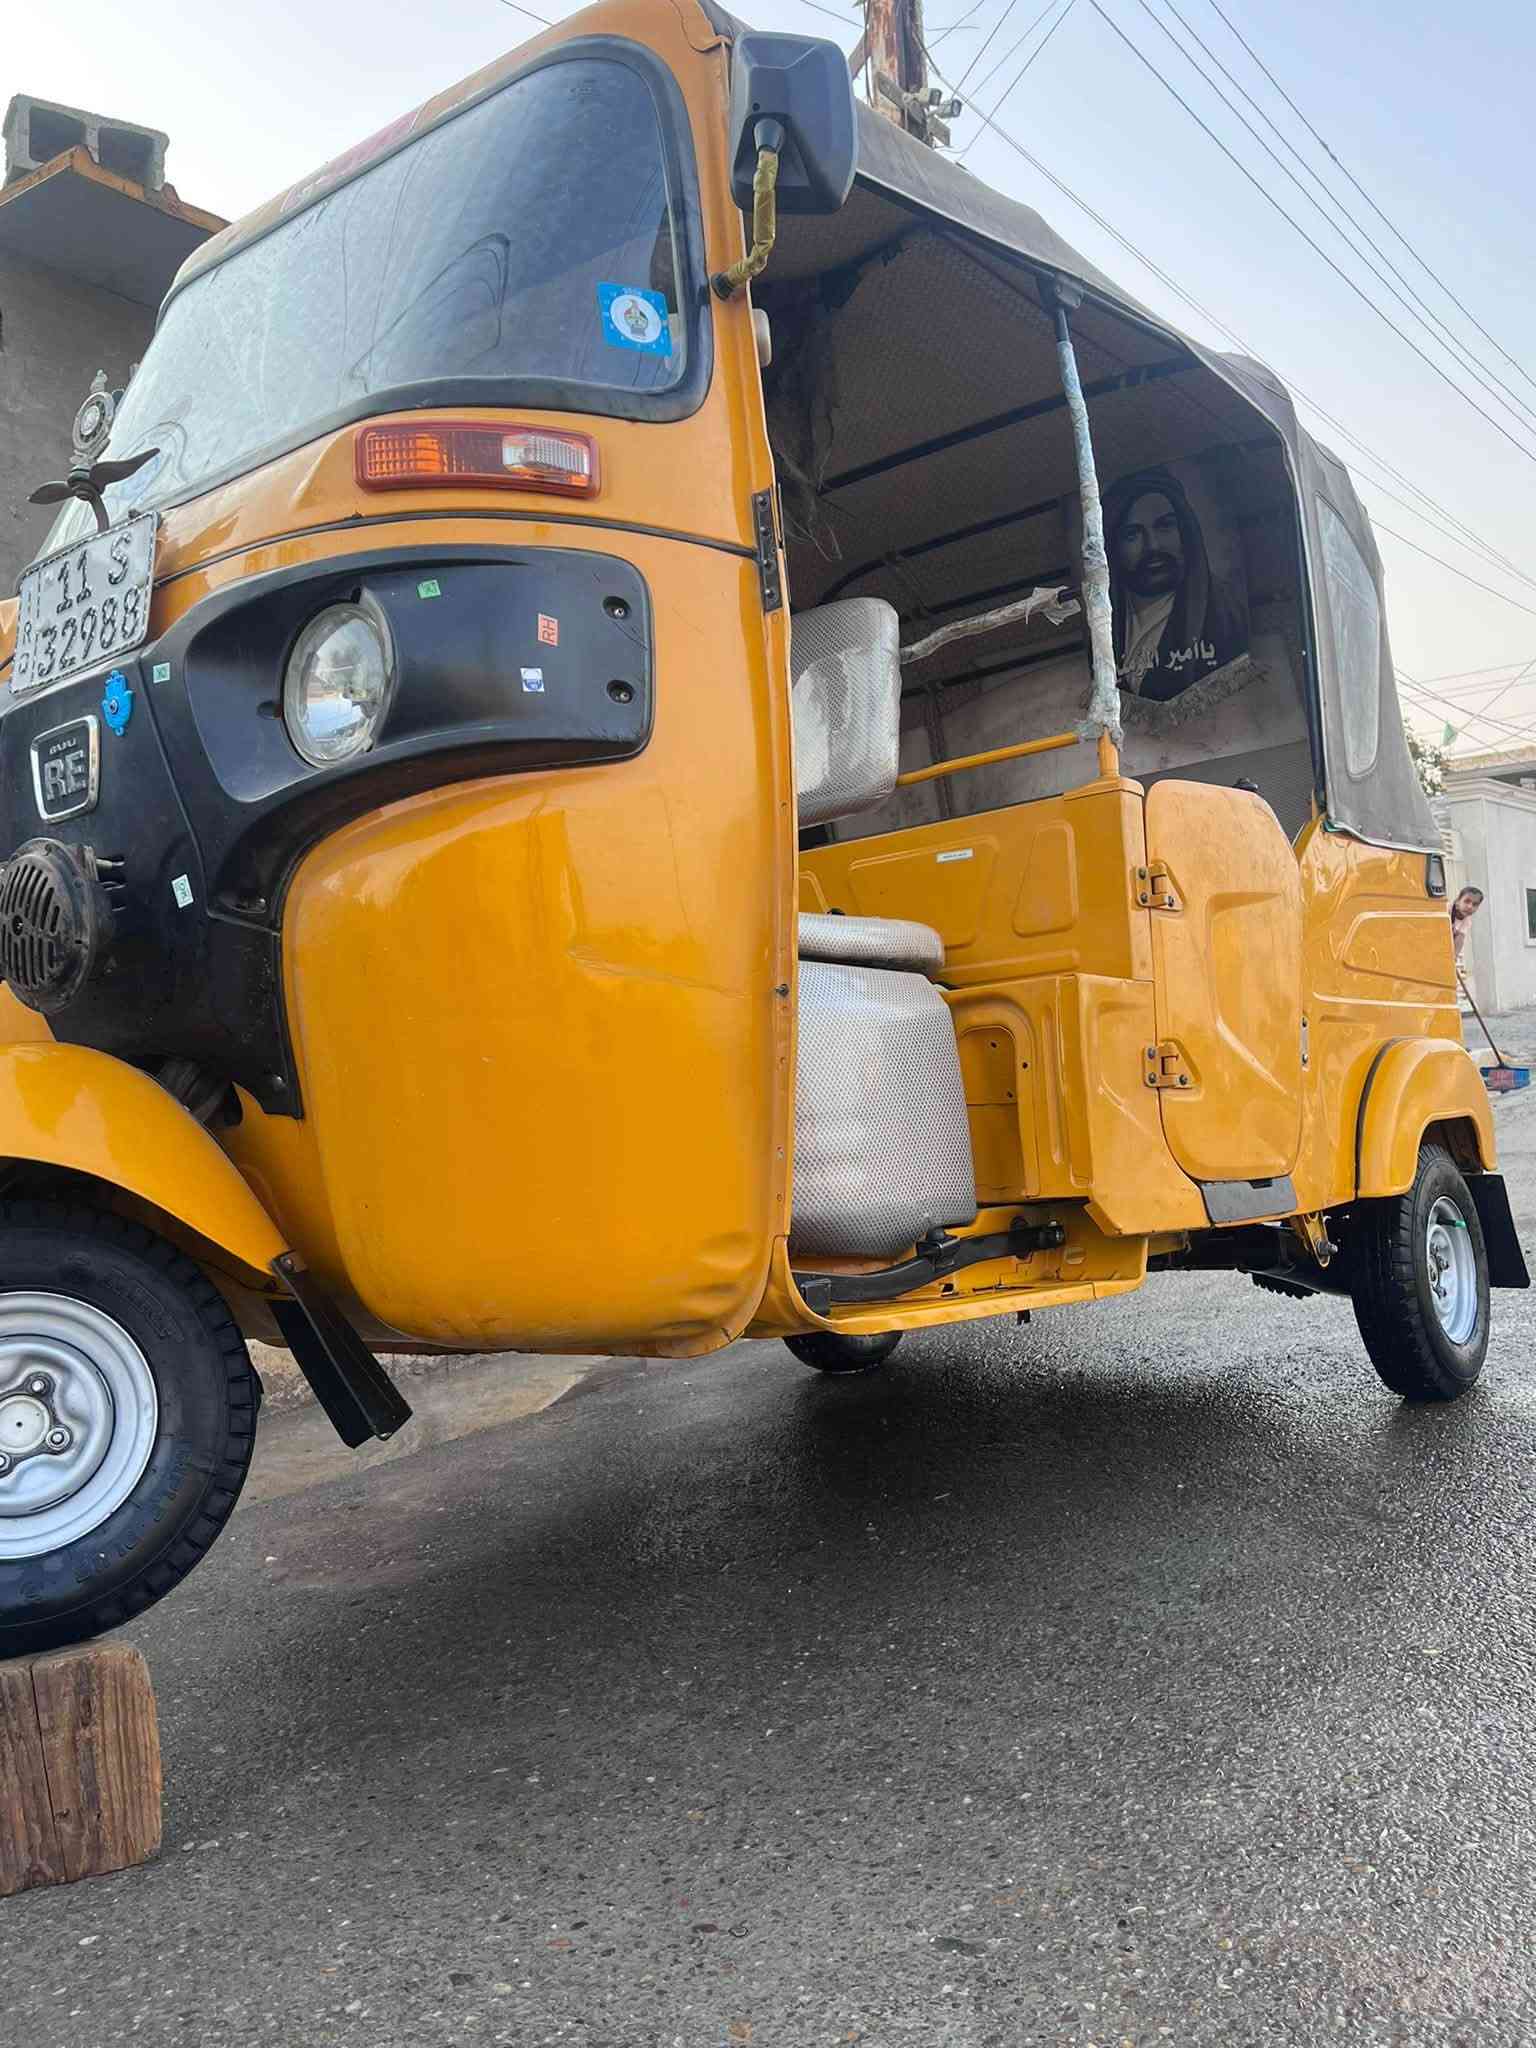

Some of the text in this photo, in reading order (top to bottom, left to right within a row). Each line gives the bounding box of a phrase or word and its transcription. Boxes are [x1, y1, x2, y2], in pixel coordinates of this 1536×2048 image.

[56, 531, 132, 614] 11 S
[37, 586, 141, 677] 32988
[541, 618, 555, 642] RH
[45, 750, 86, 800] RE
